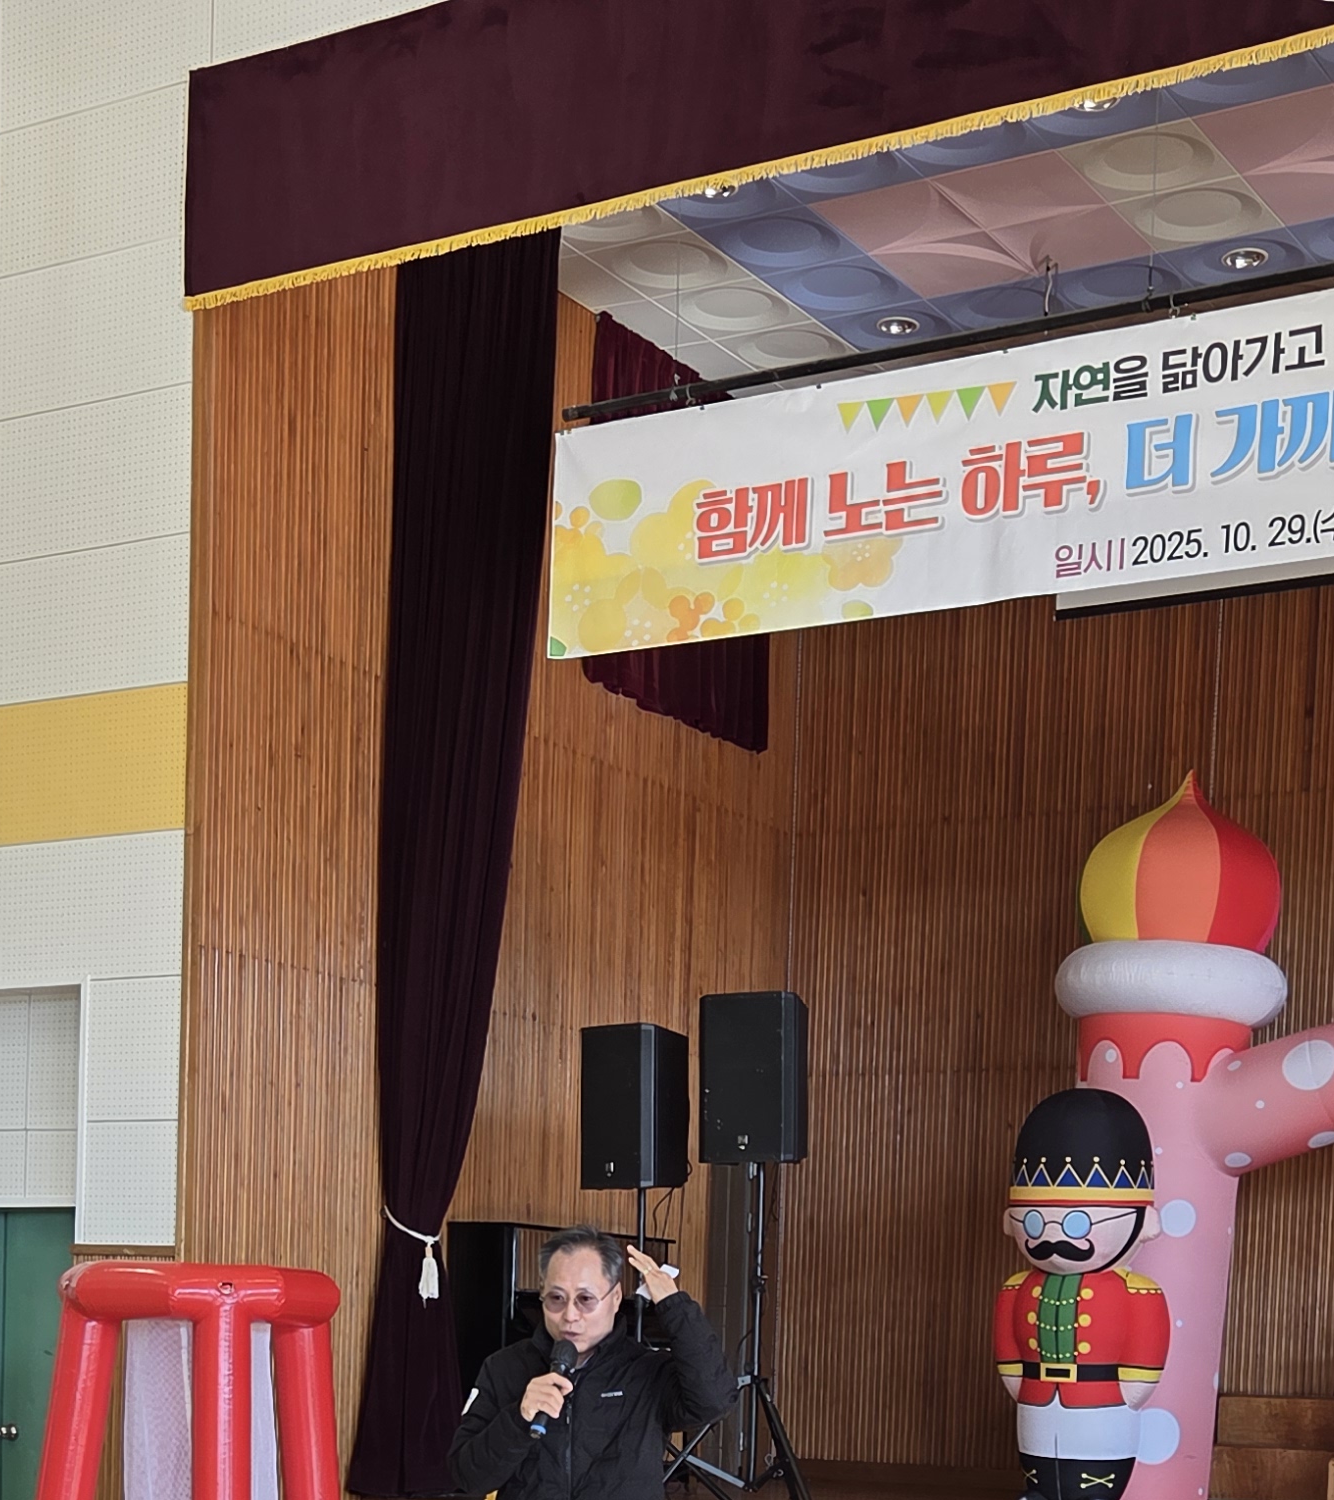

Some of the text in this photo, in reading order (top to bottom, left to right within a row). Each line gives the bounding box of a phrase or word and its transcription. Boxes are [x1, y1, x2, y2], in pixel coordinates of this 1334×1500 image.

[1031, 354, 1149, 414] 자연을
[1161, 324, 1325, 394] 닮아가고
[695, 475, 810, 561] 함께
[823, 459, 943, 538] 노는
[960, 431, 1101, 516] 하루,
[1125, 413, 1194, 490] 더
[1054, 539, 1113, 579] 일시
[1131, 528, 1210, 567] 2025.
[1221, 521, 1258, 553] 10.
